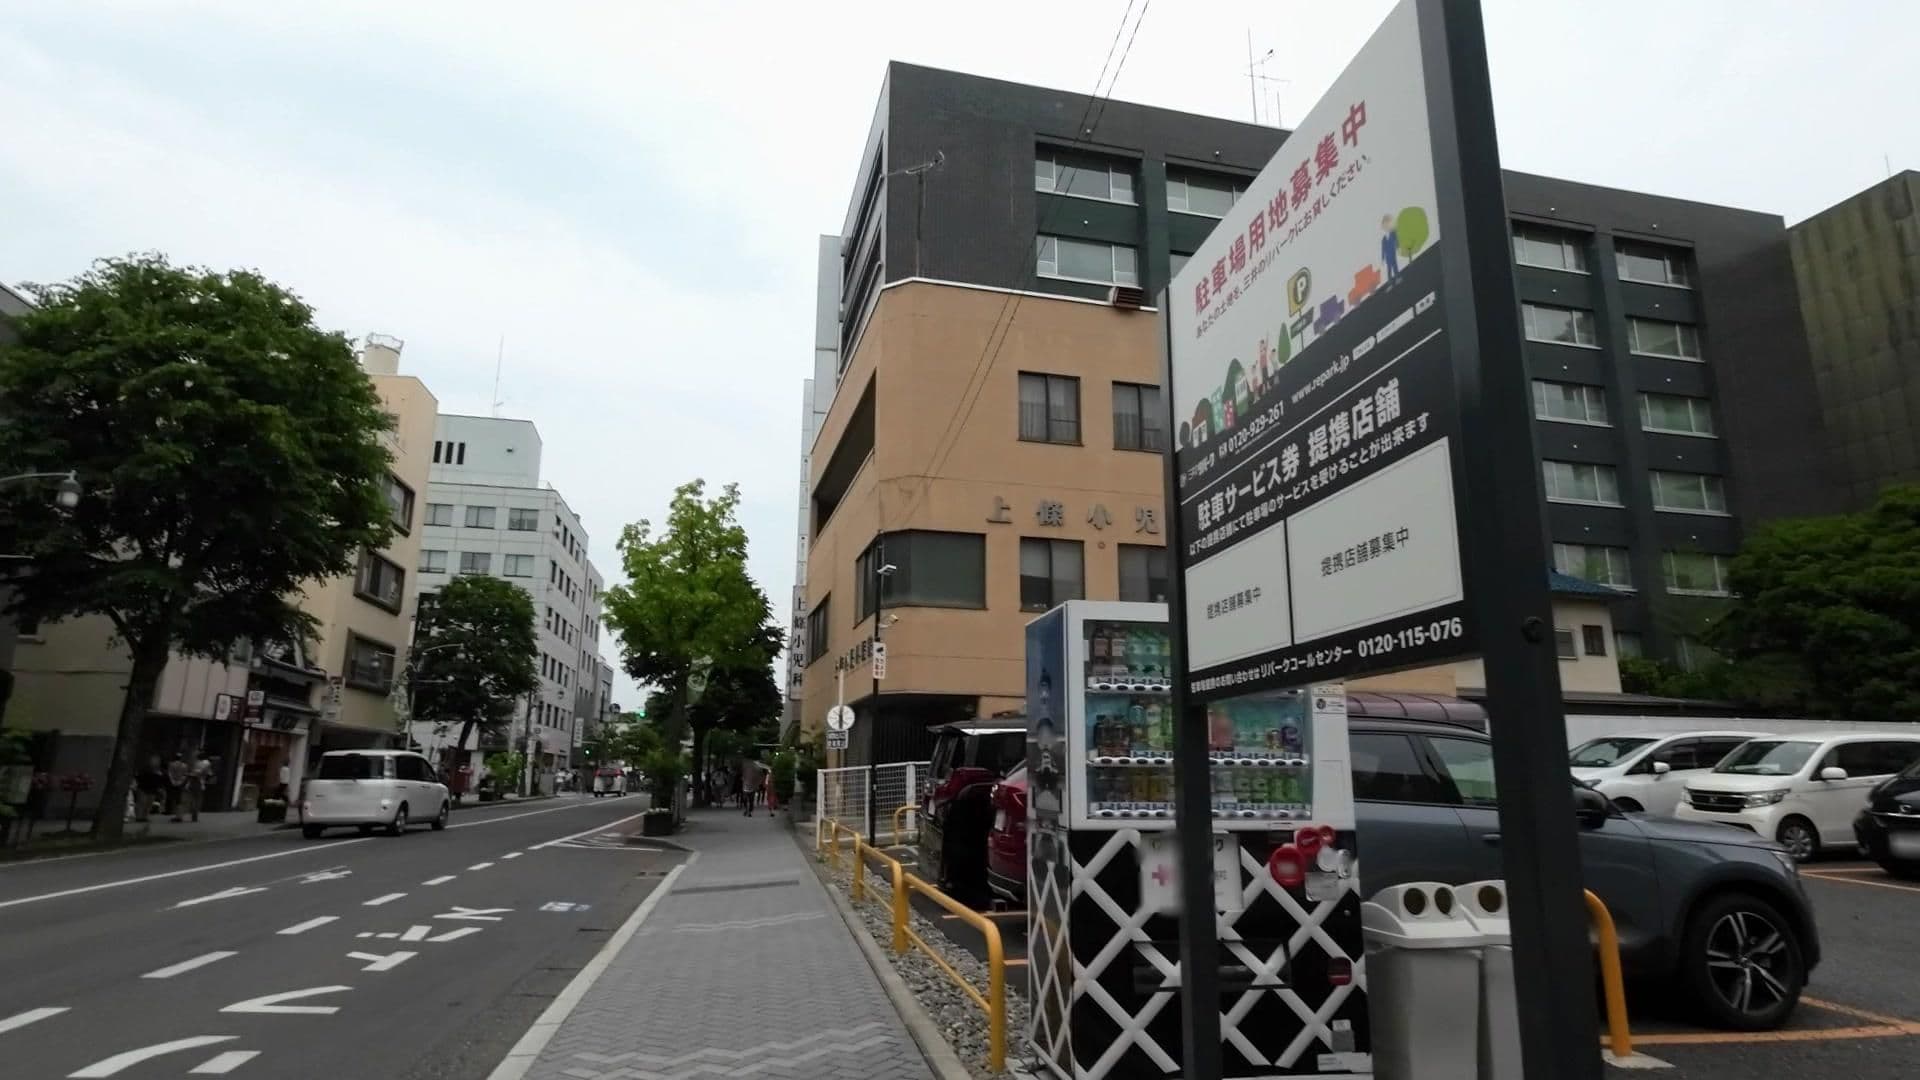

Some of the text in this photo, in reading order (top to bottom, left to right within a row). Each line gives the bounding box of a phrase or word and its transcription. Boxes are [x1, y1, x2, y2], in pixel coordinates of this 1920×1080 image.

[1194, 100, 1367, 315] 駐車場用地募集中
[1291, 354, 1351, 404] www.repark.jp
[1197, 377, 1401, 532] 駐車サービス券 提携店舗
[1320, 526, 1410, 577] 提携店舗募集中
[1357, 616, 1464, 658] 0120-115-076
